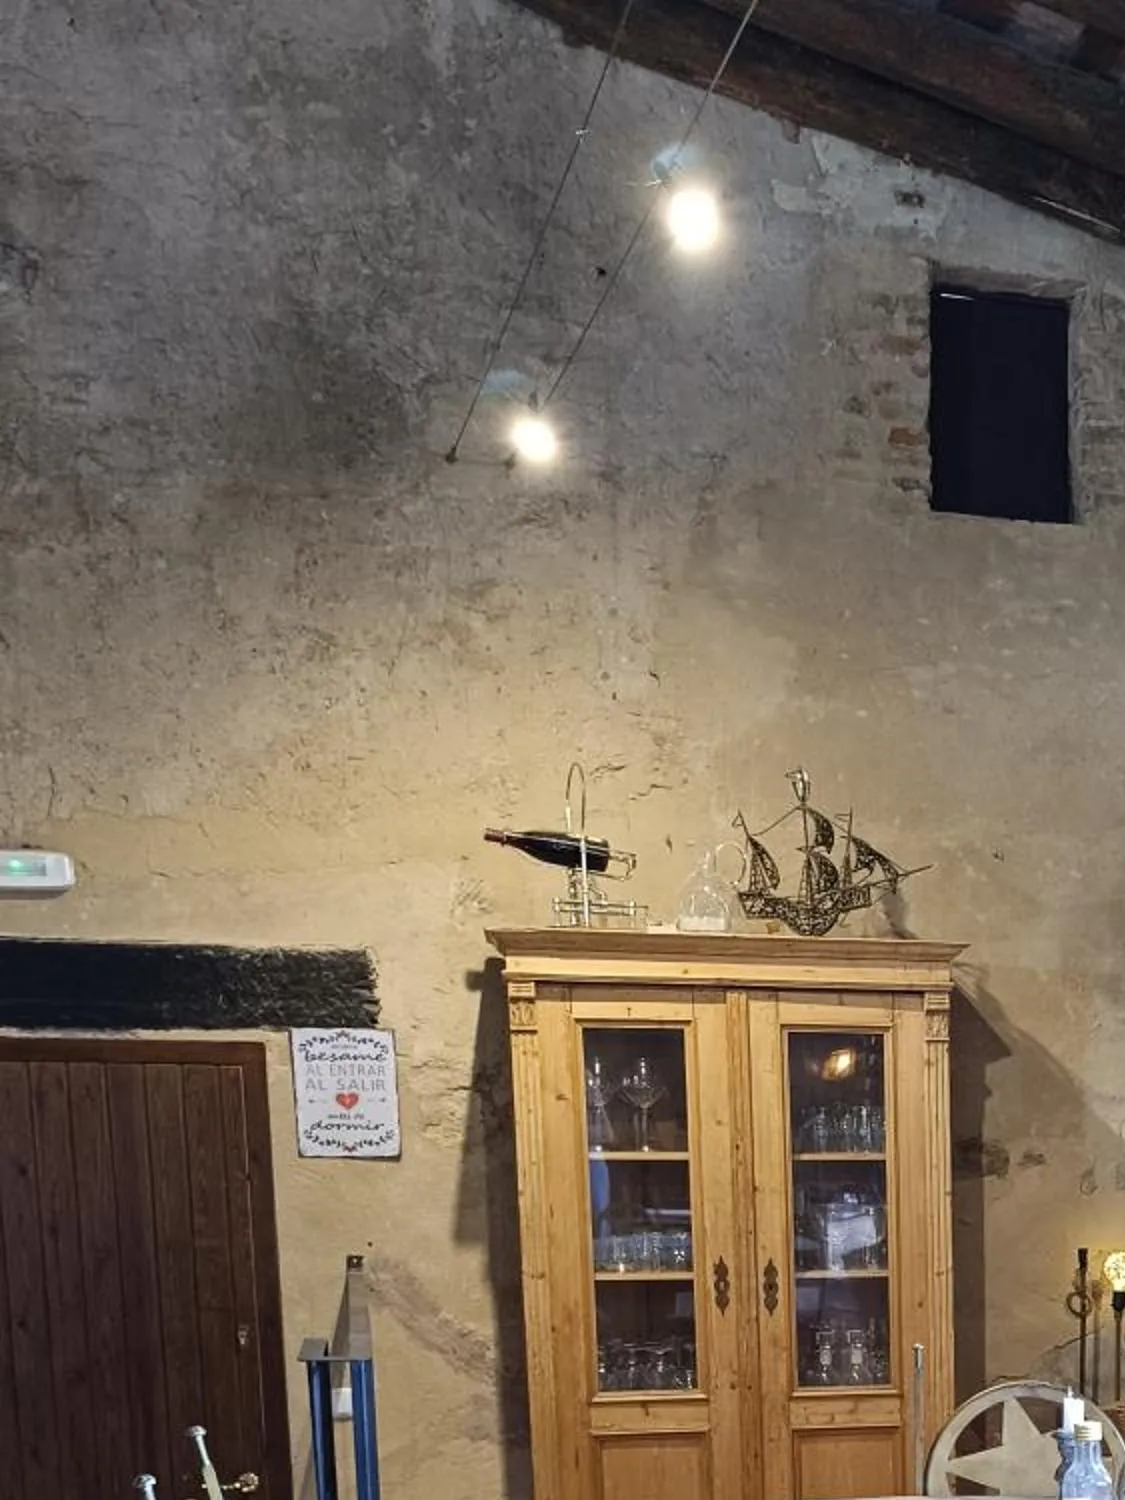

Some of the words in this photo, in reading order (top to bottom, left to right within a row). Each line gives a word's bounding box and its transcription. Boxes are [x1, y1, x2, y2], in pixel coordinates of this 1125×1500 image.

[305, 1063, 324, 1077] AL
[329, 1063, 387, 1077] ENTRAR
[305, 1078, 328, 1091] AL
[336, 1078, 386, 1092] SALIR
